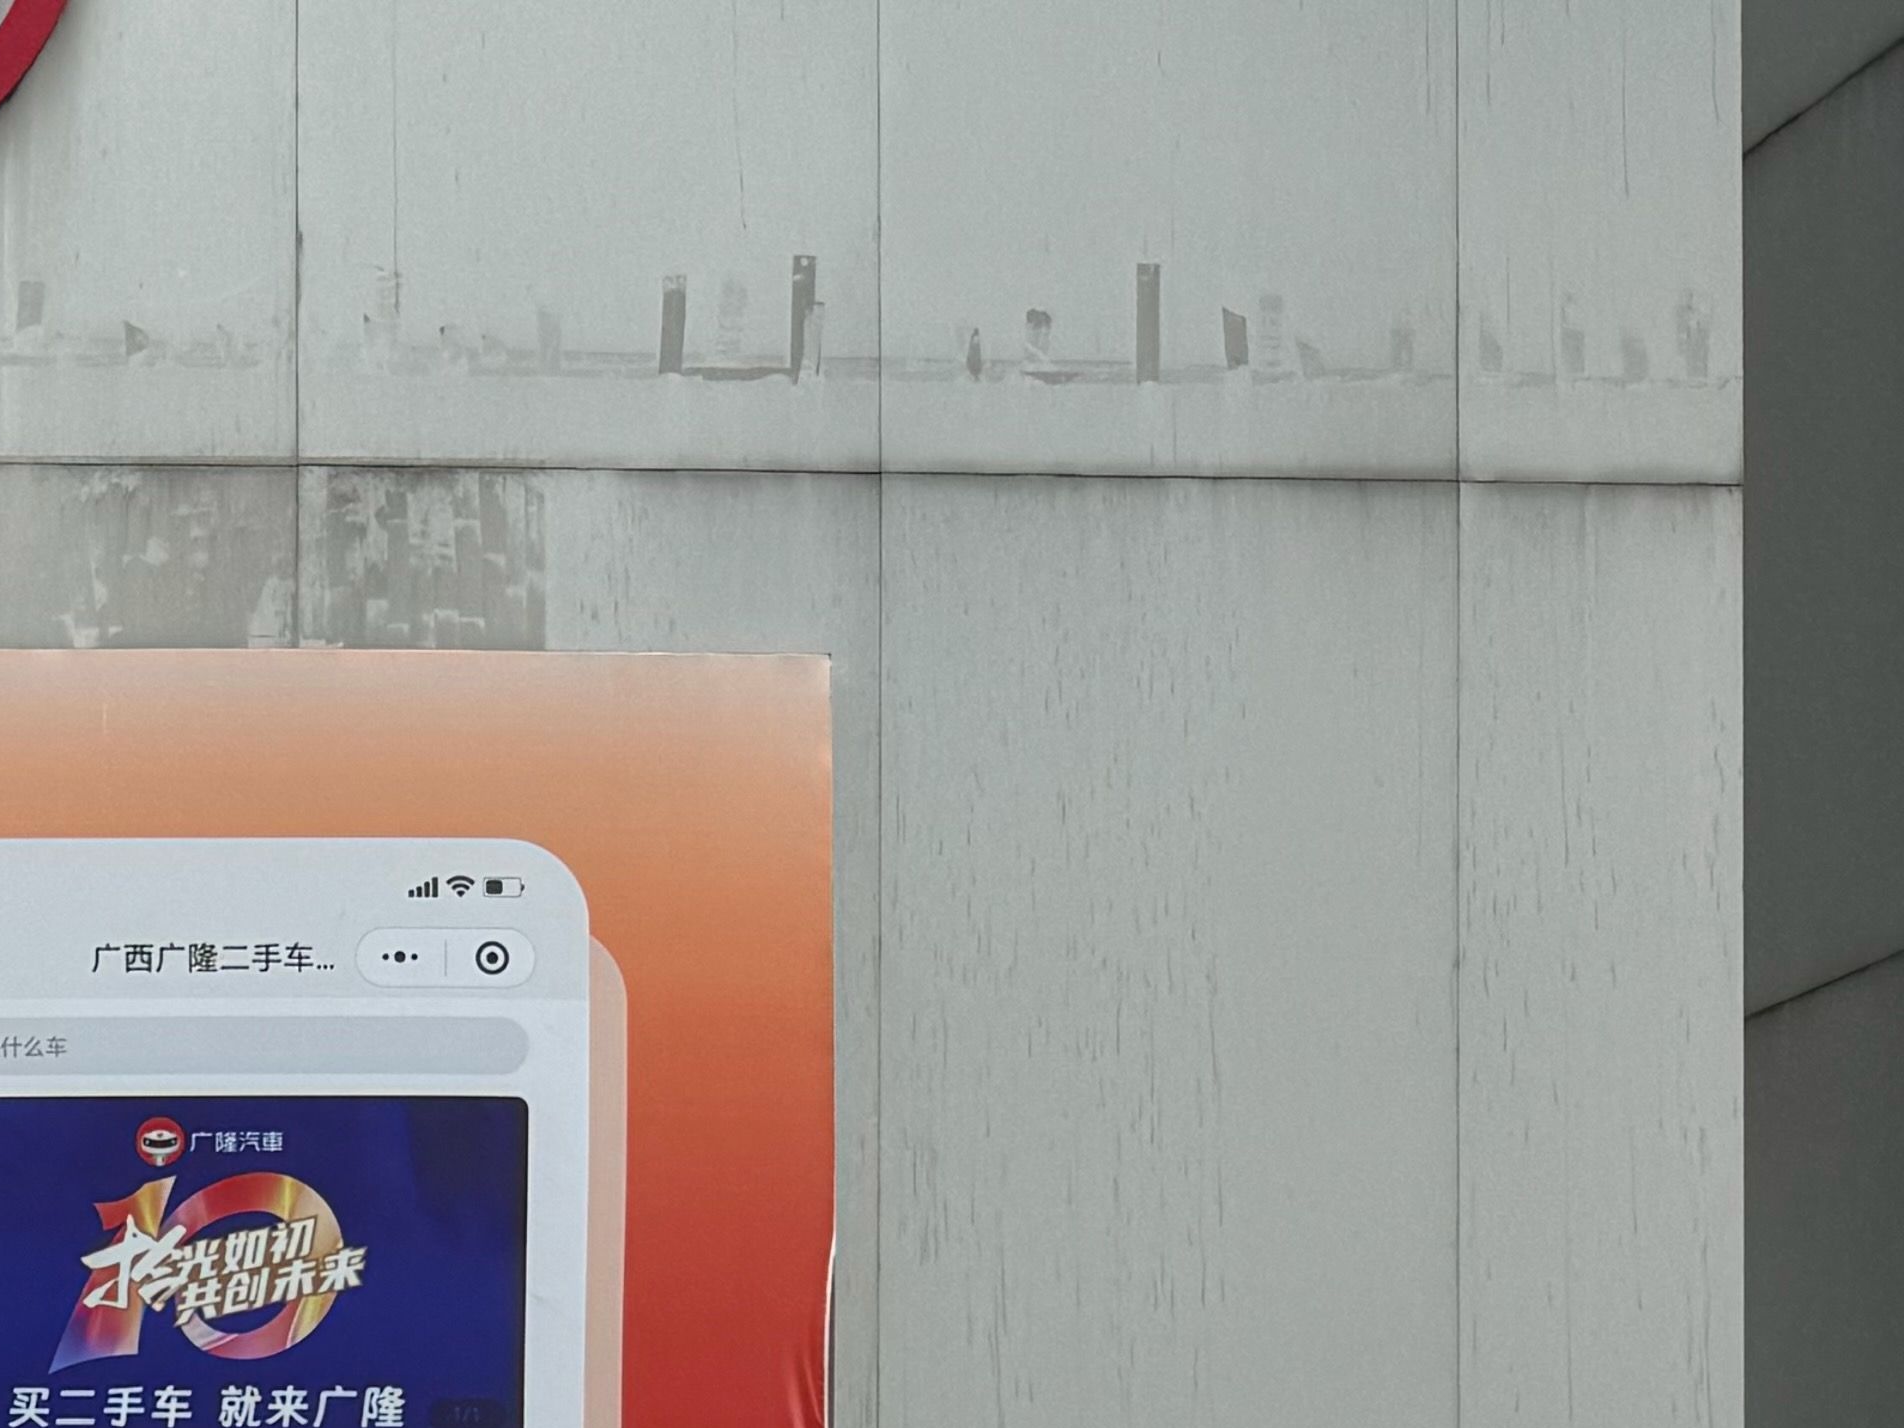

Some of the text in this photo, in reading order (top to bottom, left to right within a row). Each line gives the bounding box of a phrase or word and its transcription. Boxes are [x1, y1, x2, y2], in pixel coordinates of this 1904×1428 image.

[92, 942, 334, 973] 广西广隆二手车...
[190, 1132, 282, 1152] 广隆汽車
[173, 1245, 368, 1327] 共创未来
[9, 1385, 405, 1428] 买二手车 就来广隆
